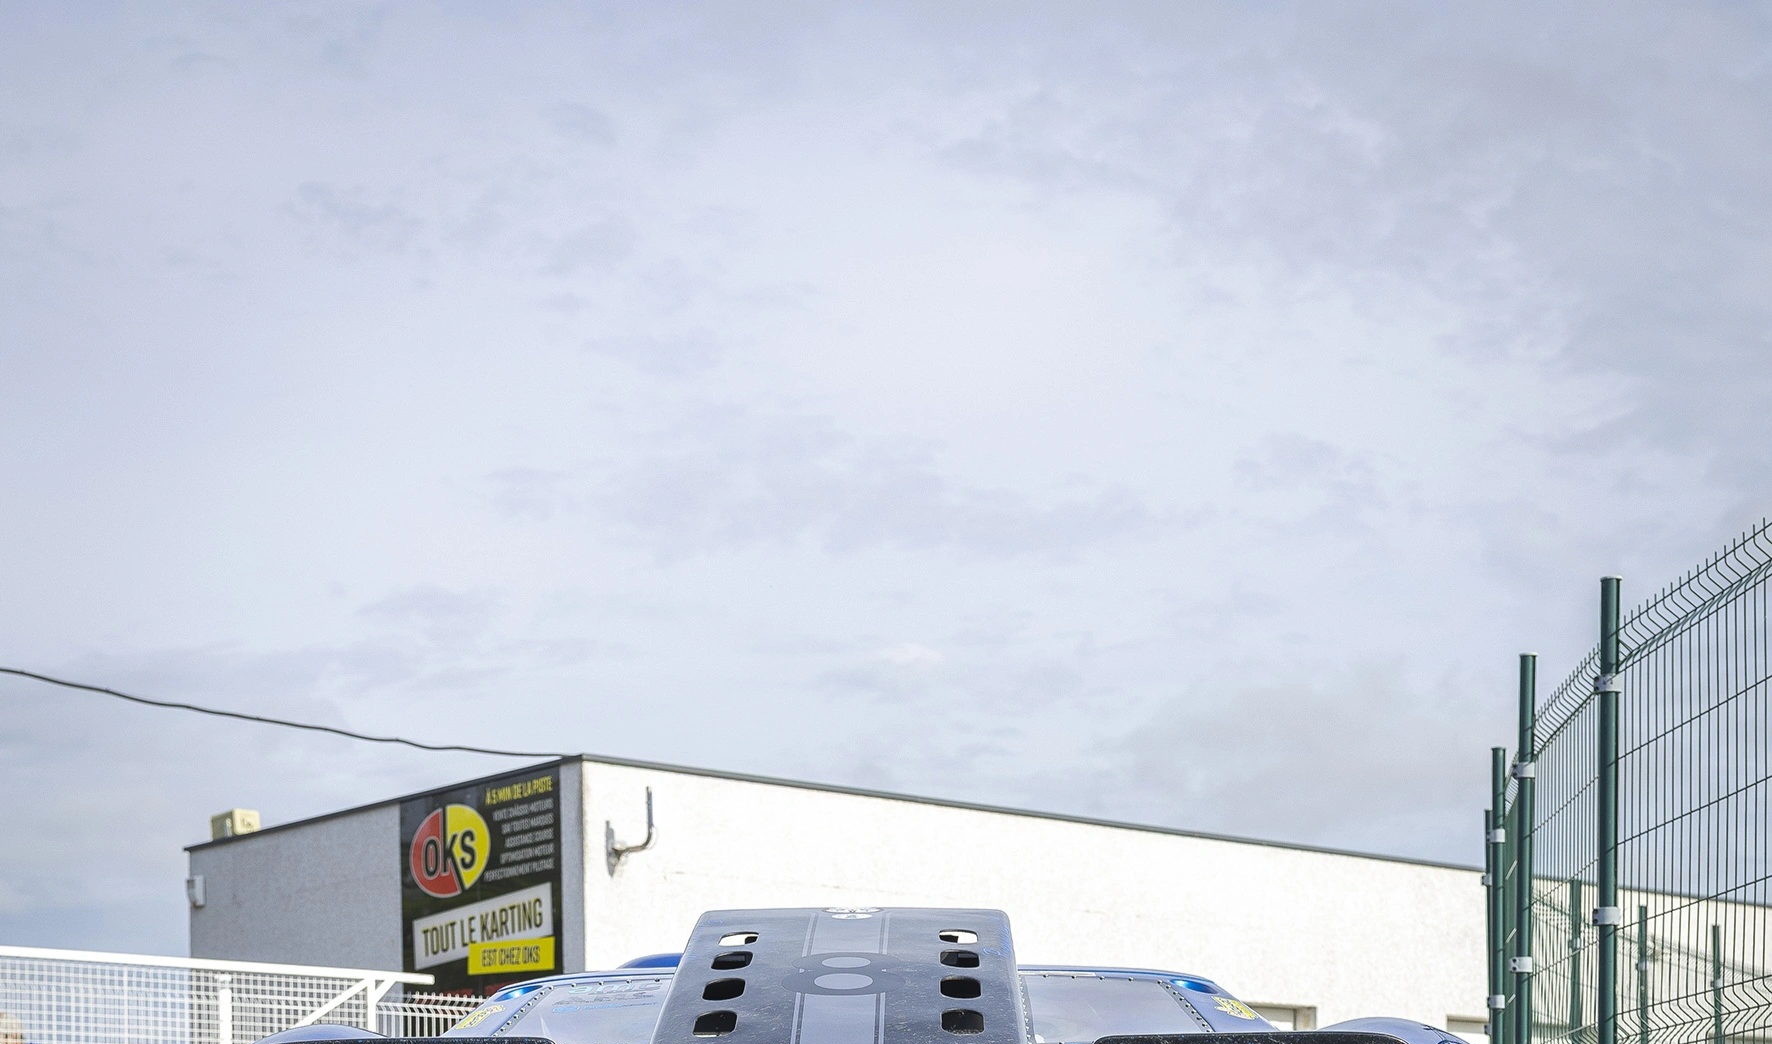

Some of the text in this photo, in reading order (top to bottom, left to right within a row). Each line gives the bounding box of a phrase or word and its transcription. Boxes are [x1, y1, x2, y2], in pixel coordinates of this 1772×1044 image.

[497, 786, 512, 803] MIN
[512, 783, 522, 799] DE
[522, 781, 532, 798] LA
[532, 775, 553, 795] PISTE
[422, 898, 543, 957] TOUT LE KARTING
[481, 946, 541, 967] EST CHEZ OKS
